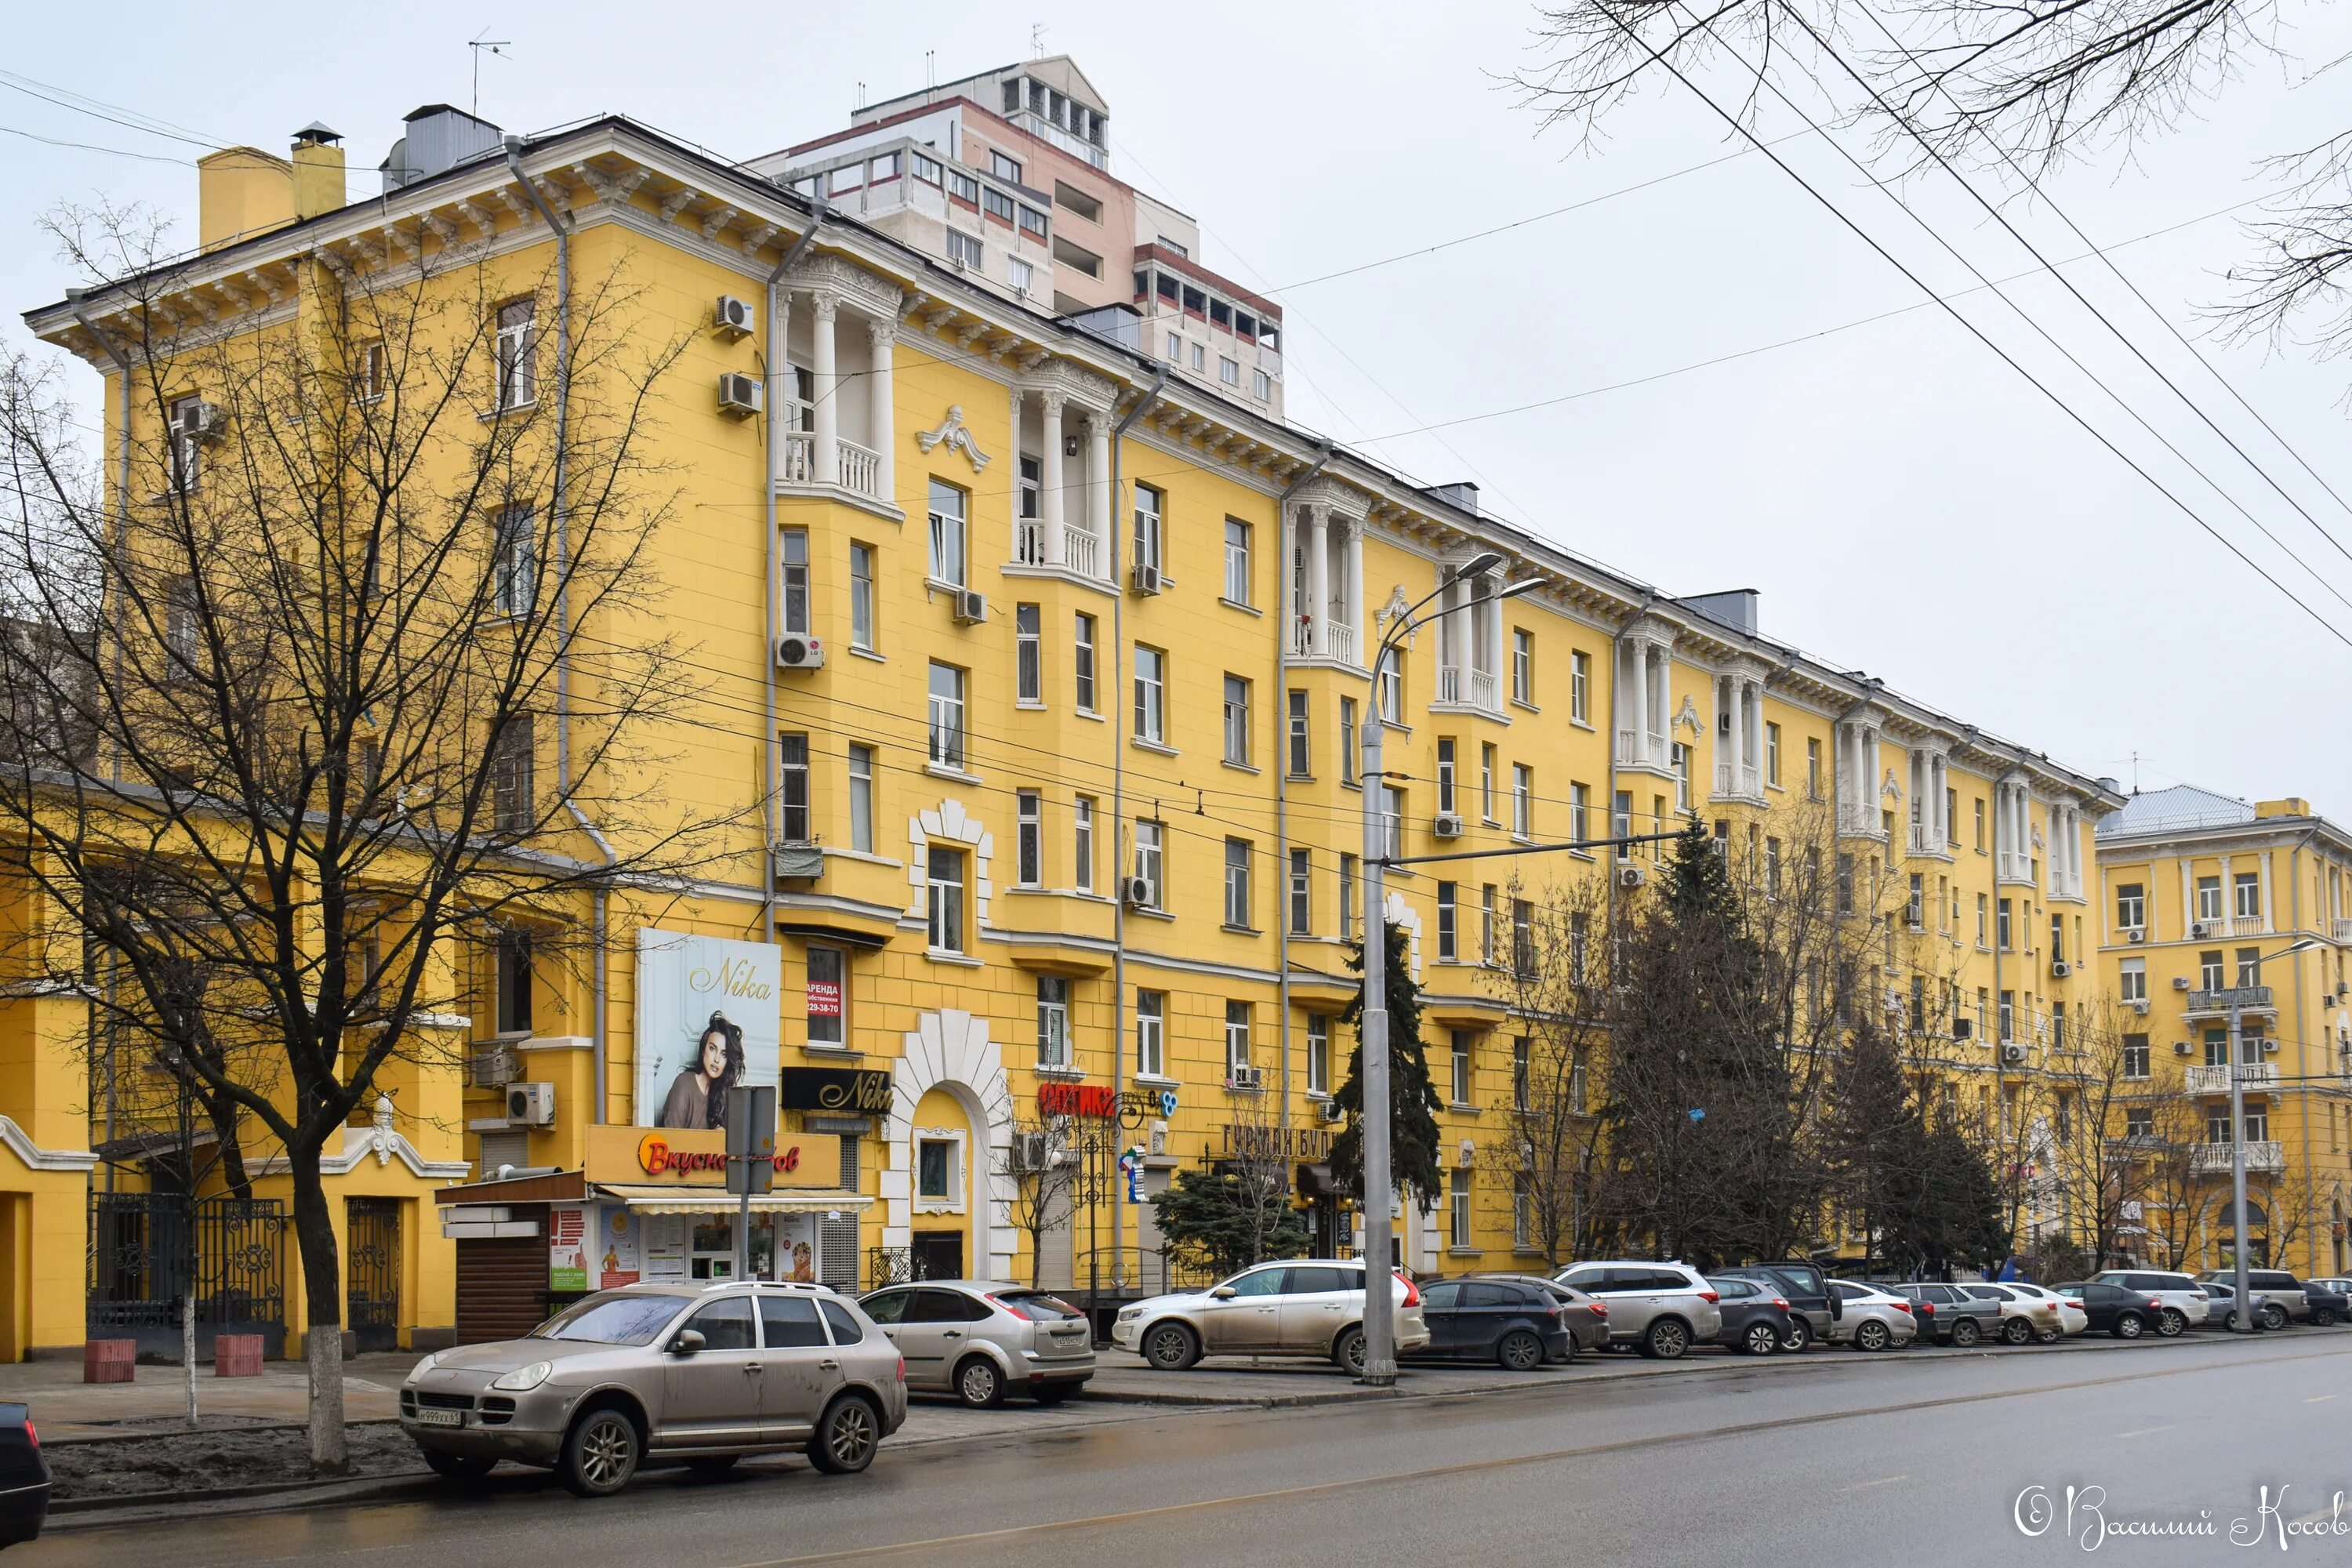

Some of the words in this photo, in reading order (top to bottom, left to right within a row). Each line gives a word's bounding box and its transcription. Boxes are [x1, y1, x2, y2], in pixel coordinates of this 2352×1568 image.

[690, 956, 771, 1000] Nika
[808, 984, 838, 996] АРЕНДА
[818, 1072, 894, 1109] Nika
